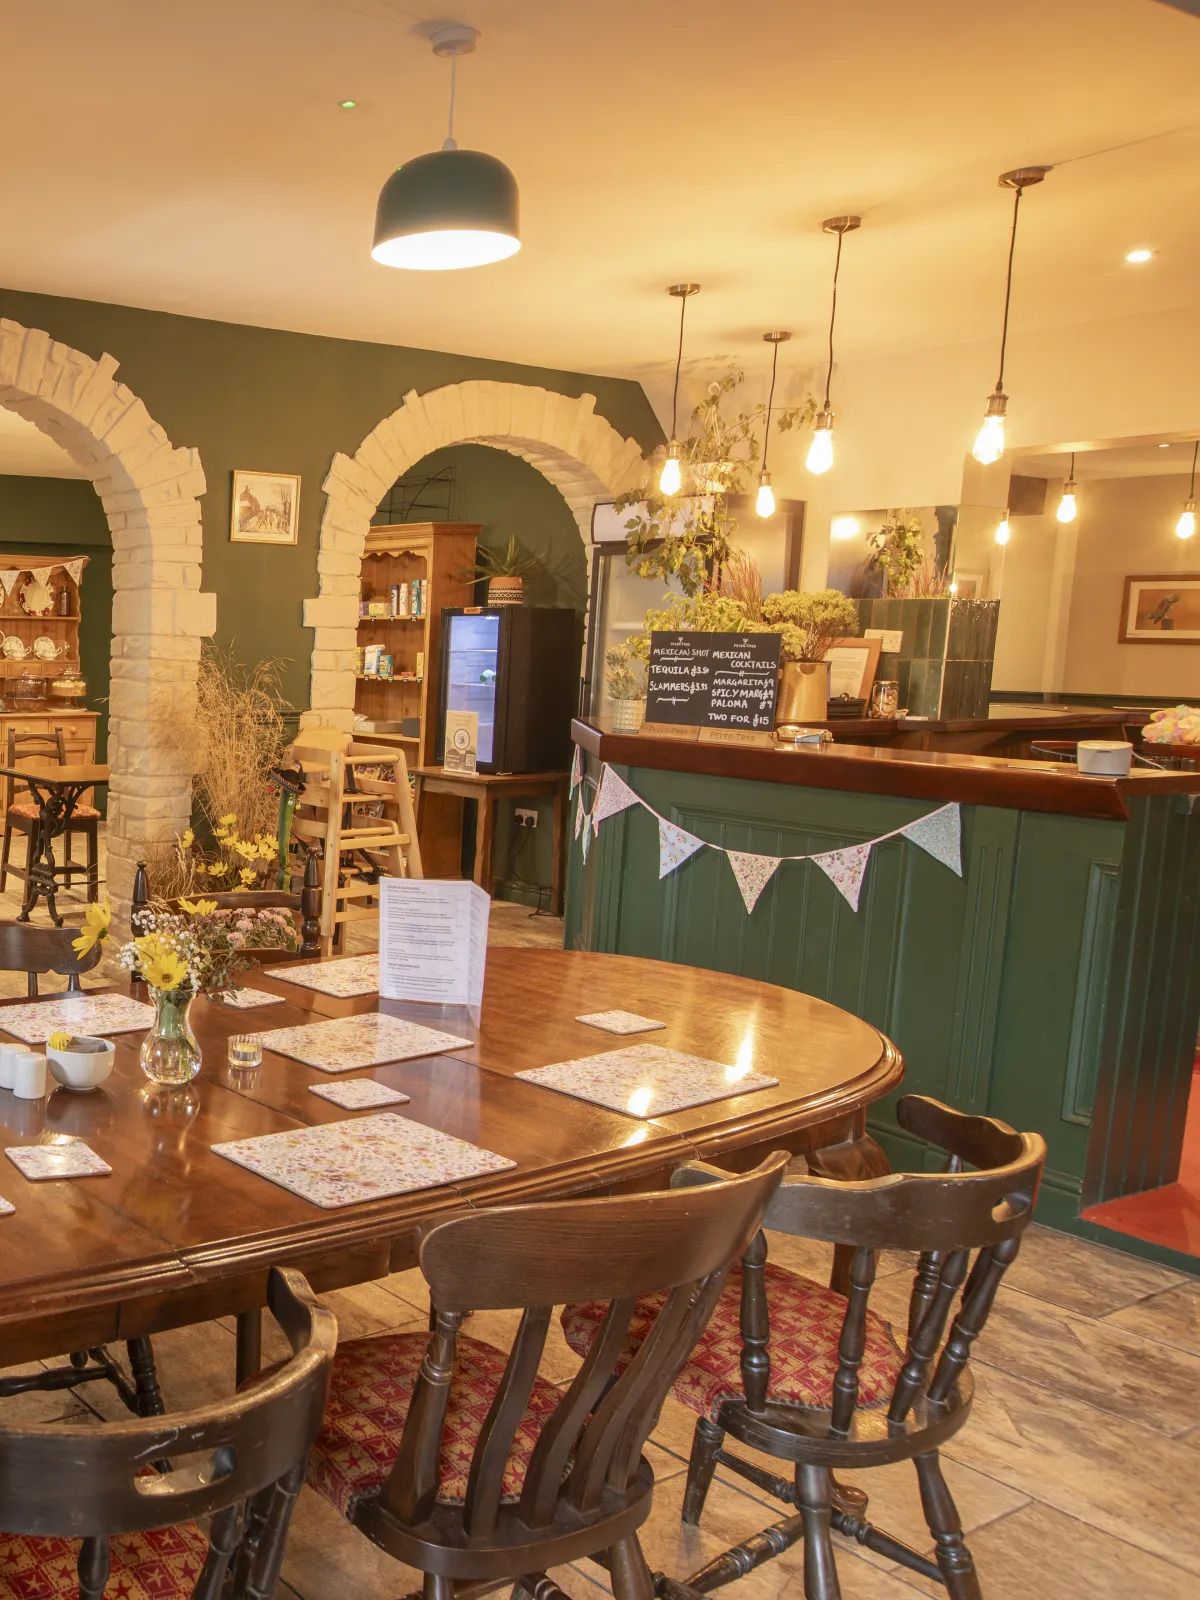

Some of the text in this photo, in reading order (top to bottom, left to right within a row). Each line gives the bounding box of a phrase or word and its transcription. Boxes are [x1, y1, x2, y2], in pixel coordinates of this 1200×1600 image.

[692, 649, 710, 657] SHOT
[712, 651, 751, 659] MEXICAN
[731, 661, 777, 669] COCKTAILS
[651, 665, 690, 675] TEQUILA
[649, 682, 690, 692] SLAMMERS
[713, 679, 763, 687] MARGARITA
[712, 689, 739, 698] SPICY
[739, 689, 763, 700] MARG
[711, 700, 748, 709] PALOMA
[708, 713, 770, 727] TWO FOR £15
